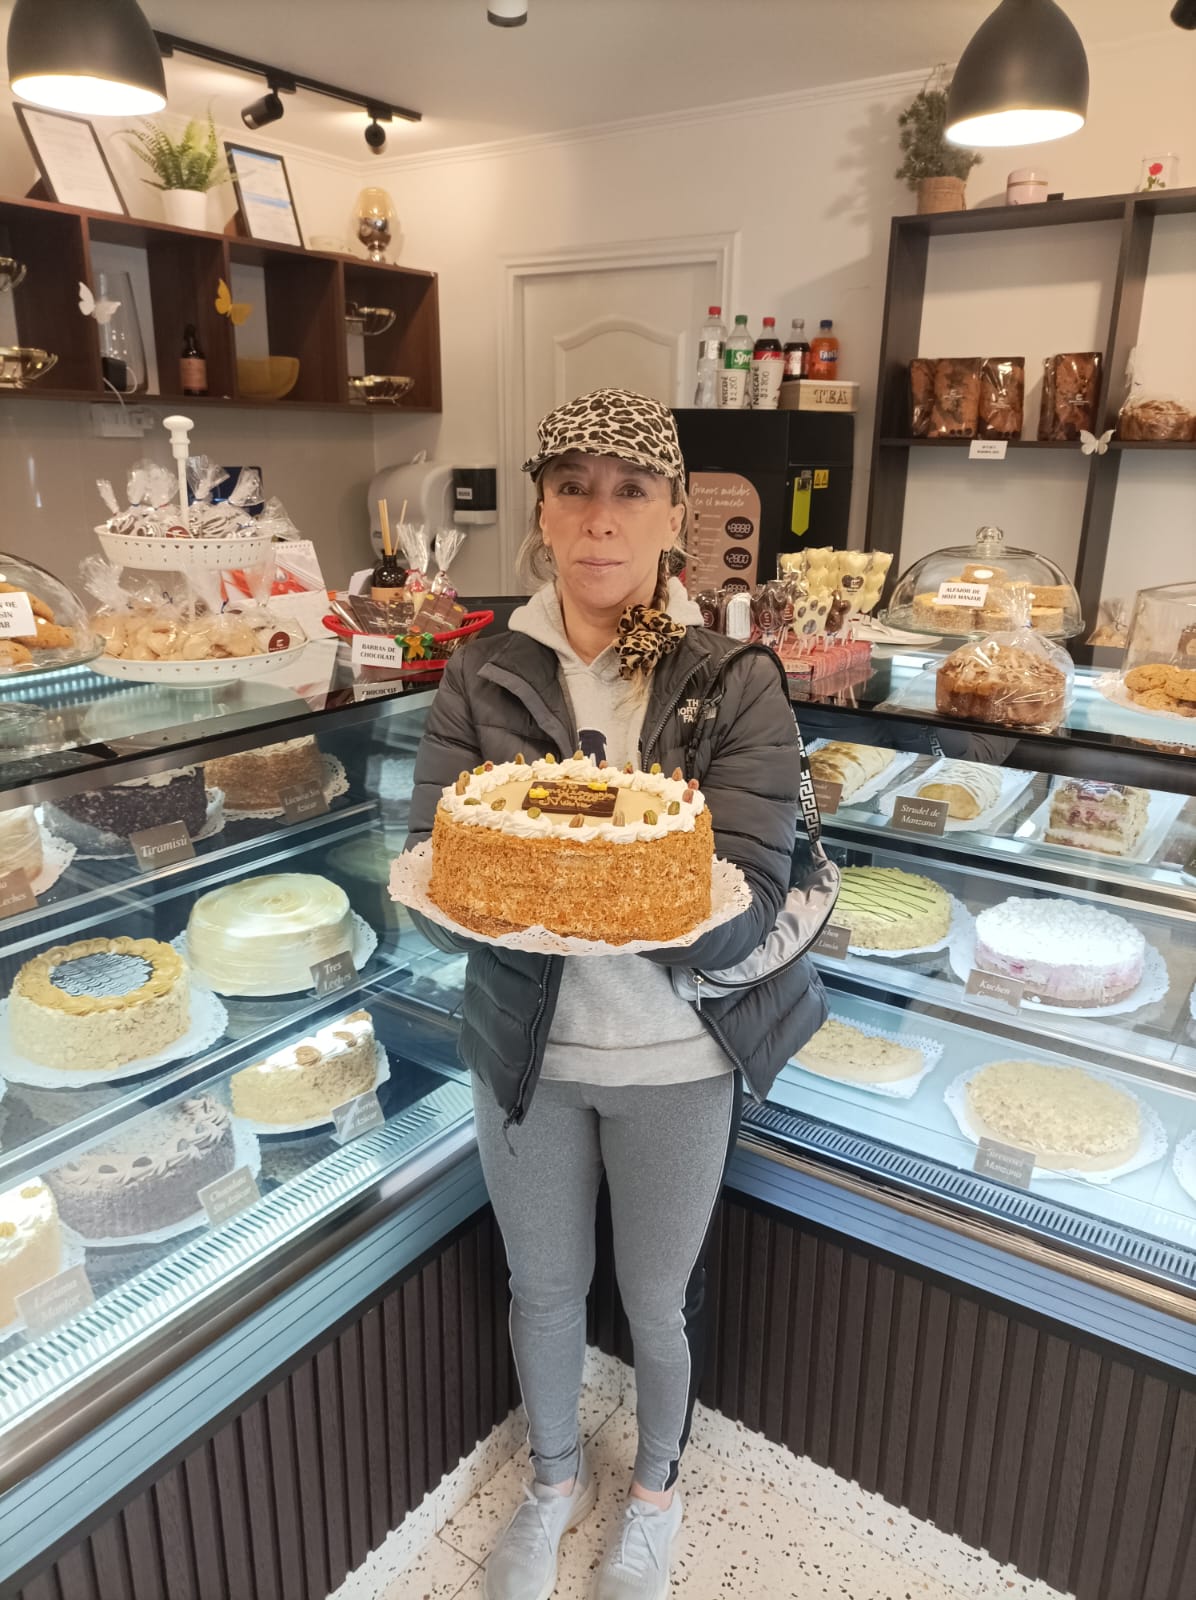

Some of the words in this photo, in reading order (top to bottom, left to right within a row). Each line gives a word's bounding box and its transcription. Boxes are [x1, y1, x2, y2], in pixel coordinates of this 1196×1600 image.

[735, 351, 751, 365] Spr
[814, 389, 848, 404] TEA
[360, 652, 395, 660] CHOCOLATE
[686, 699, 699, 707] TH
[677, 707, 697, 716] ORT
[901, 804, 929, 815] Strudel
[901, 815, 937, 828] Manzana
[140, 834, 187, 857] Tiramisú
[323, 962, 342, 975] Tres
